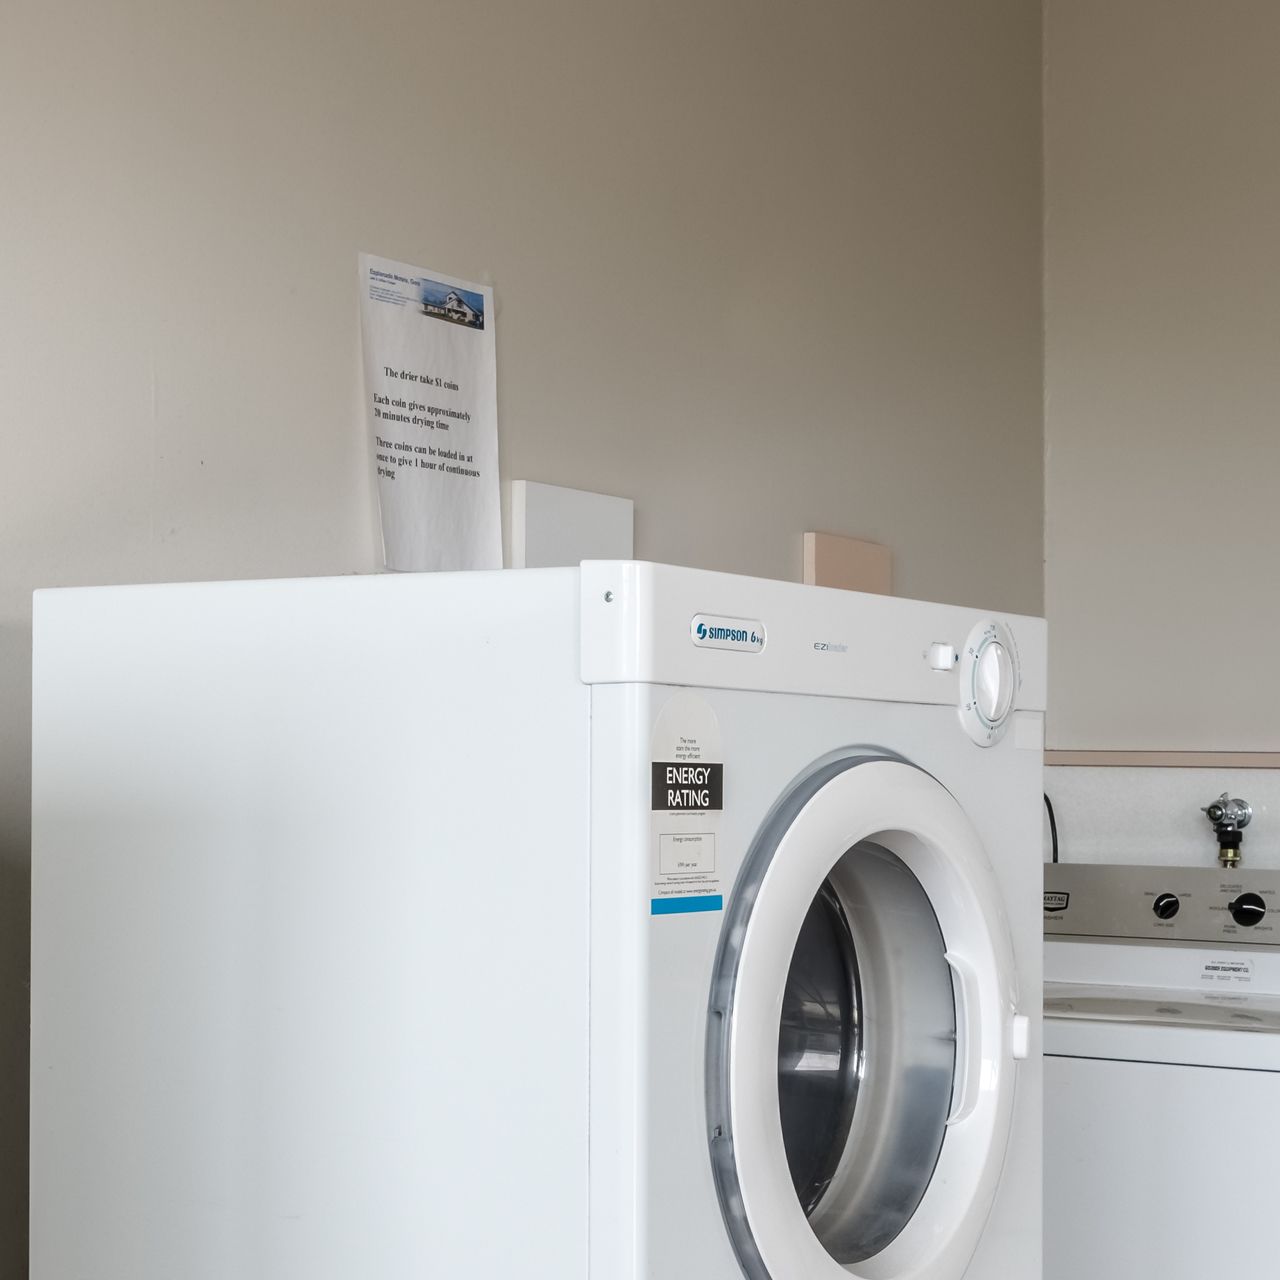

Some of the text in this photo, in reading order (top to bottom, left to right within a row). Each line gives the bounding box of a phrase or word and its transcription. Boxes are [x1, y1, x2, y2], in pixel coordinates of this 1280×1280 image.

[383, 366, 399, 379] The
[400, 369, 419, 382] drier
[420, 375, 434, 386] take
[444, 380, 459, 391] coins
[373, 392, 471, 424] Each coin gives approximately
[374, 407, 449, 431] 20 minutes drying time
[376, 436, 473, 463] Three coins can be loaded in at
[389, 455, 397, 463] to
[398, 456, 413, 467] give
[420, 459, 437, 470] hour
[438, 462, 445, 472] of
[445, 464, 480, 478] continuous
[708, 626, 748, 642] SIMPSON
[666, 767, 711, 784] ENERGY
[667, 789, 710, 807] RATING
